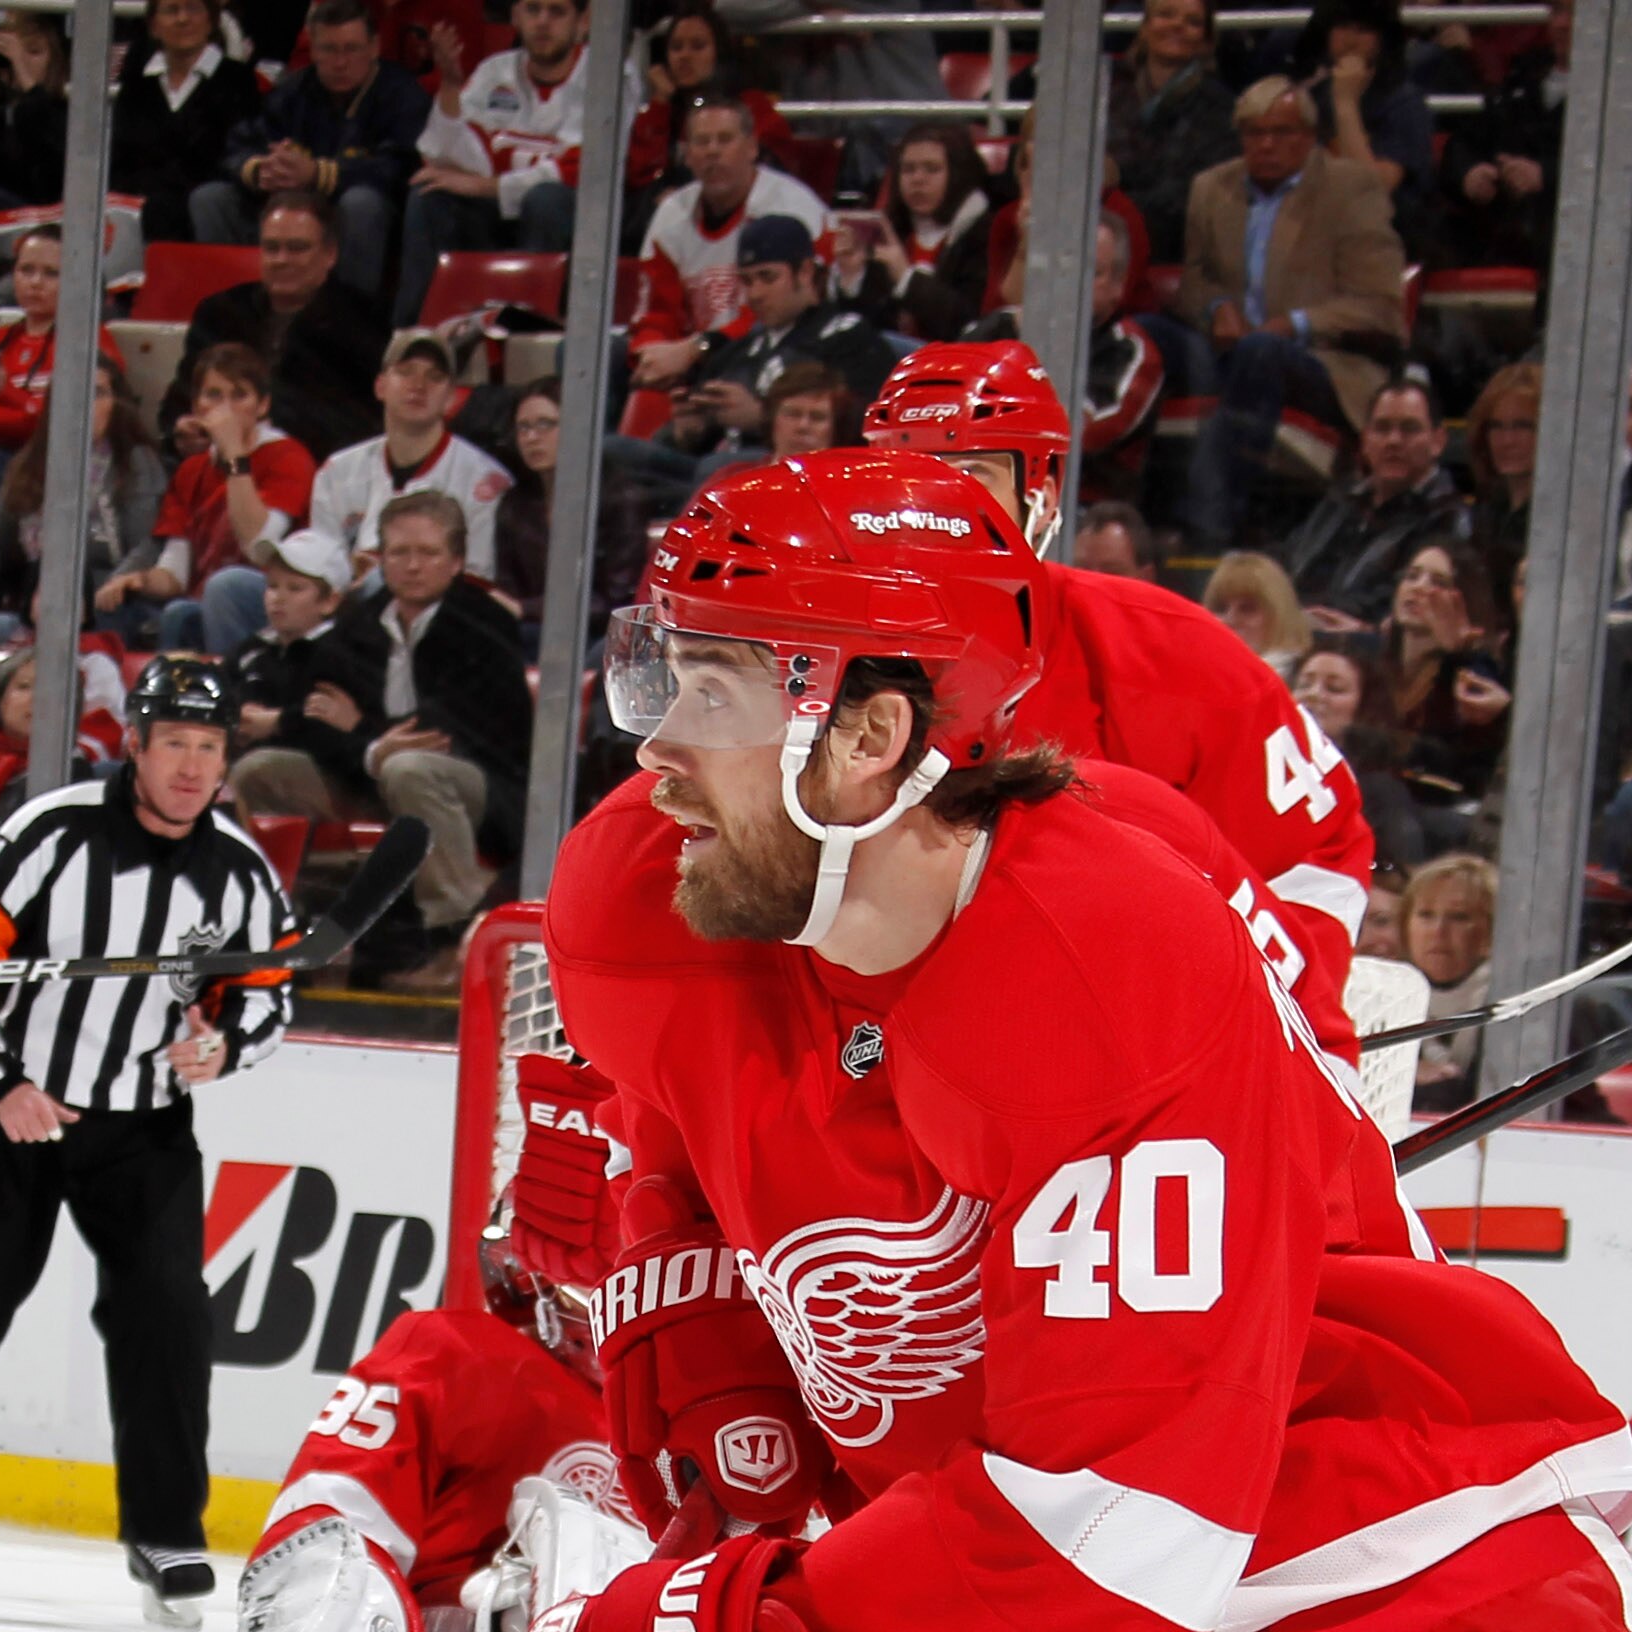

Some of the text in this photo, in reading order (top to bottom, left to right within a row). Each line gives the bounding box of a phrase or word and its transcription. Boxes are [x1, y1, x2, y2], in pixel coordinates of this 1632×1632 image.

[850, 510, 971, 537] Red Wings
[849, 1041, 881, 1062] NHL
[1012, 1138, 1226, 1319] 40
